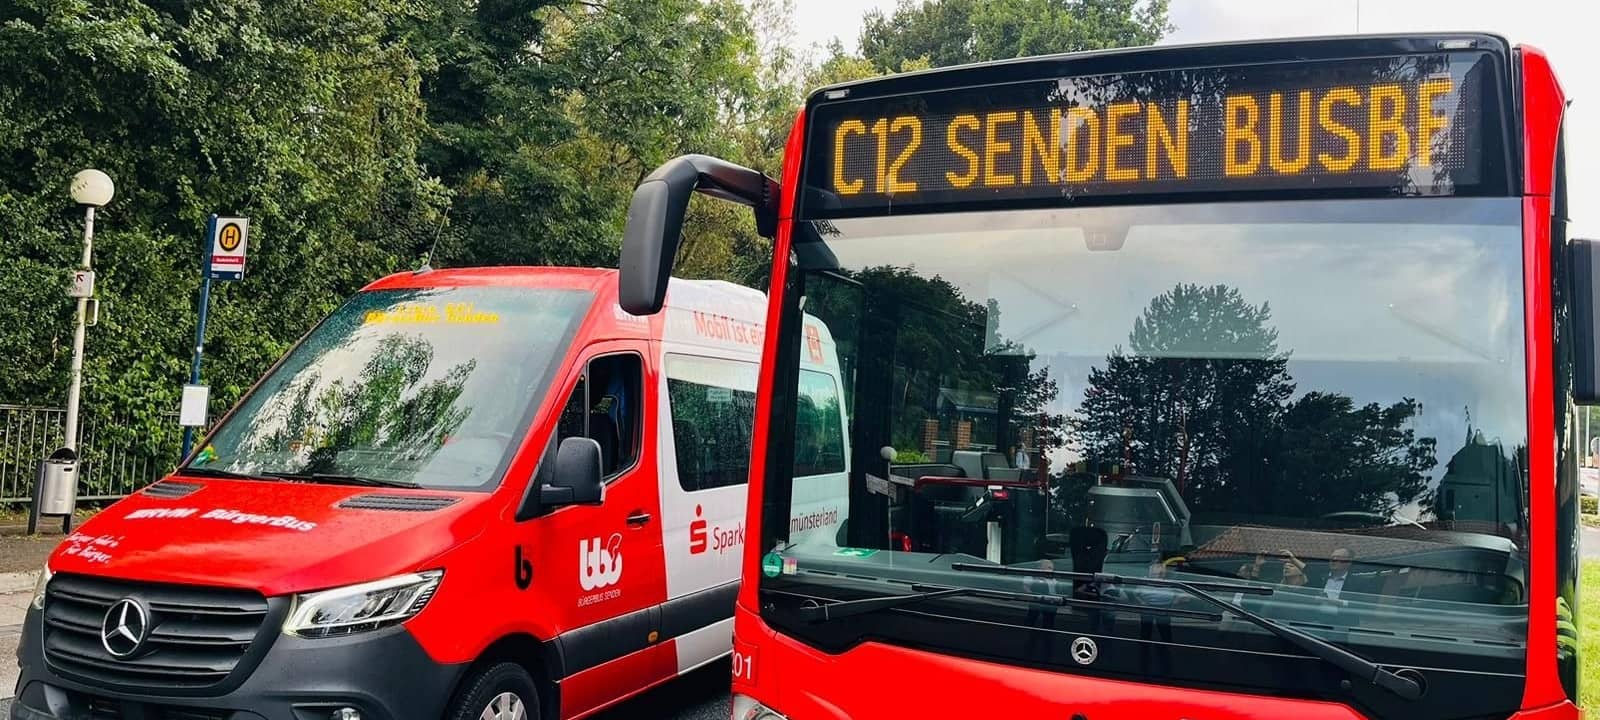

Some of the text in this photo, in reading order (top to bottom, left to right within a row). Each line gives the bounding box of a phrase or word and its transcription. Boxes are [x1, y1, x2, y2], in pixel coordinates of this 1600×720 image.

[833, 116, 922, 195] C12
[945, 99, 1189, 188] SENDEN
[200, 509, 318, 532] BürgerBus
[712, 523, 744, 554] Spark
[790, 507, 838, 534] münsterland
[732, 652, 752, 680] 01
